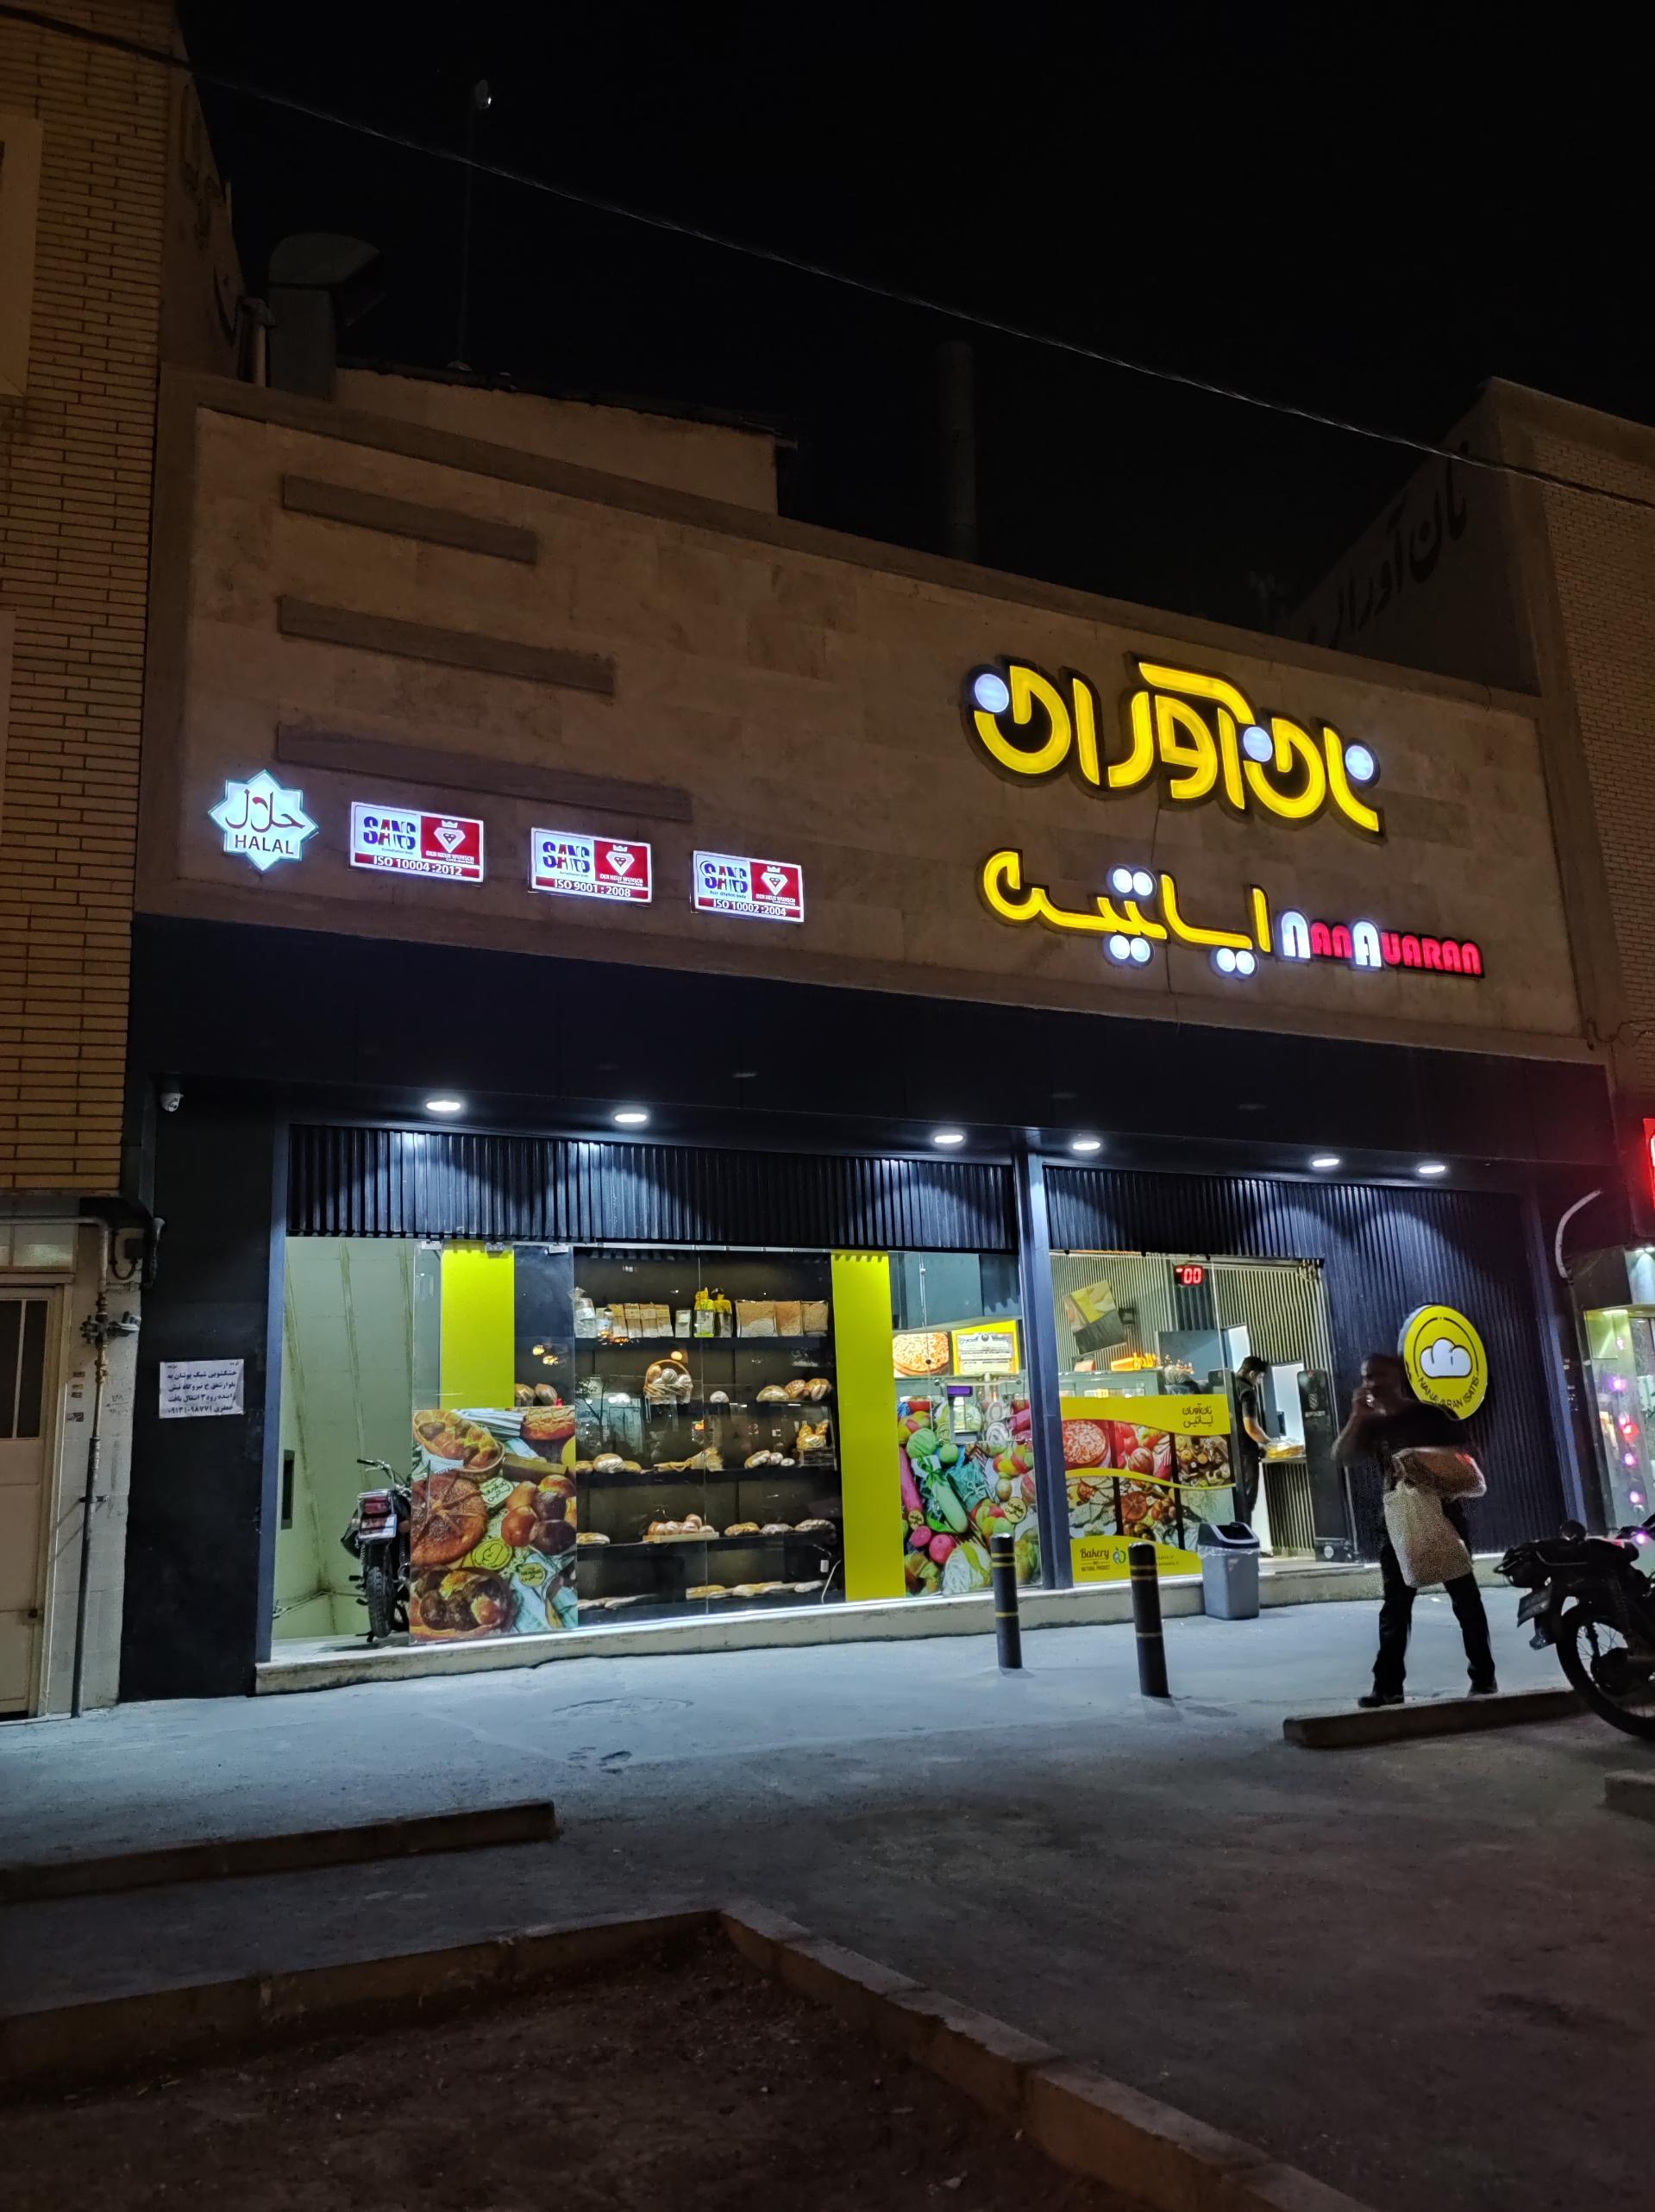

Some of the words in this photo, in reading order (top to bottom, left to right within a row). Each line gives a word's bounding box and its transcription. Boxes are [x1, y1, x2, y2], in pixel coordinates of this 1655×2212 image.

[225, 788, 305, 833] حلال
[235, 834, 294, 855] HALAL
[373, 855, 392, 867] ISO
[396, 860, 429, 872] 10004
[555, 880, 572, 890] ISO
[574, 881, 598, 893] 9001
[606, 886, 630, 897] 2008
[713, 899, 729, 909] ISO
[732, 902, 759, 912] 10002
[1080, 1547, 1110, 1559] Bakery
